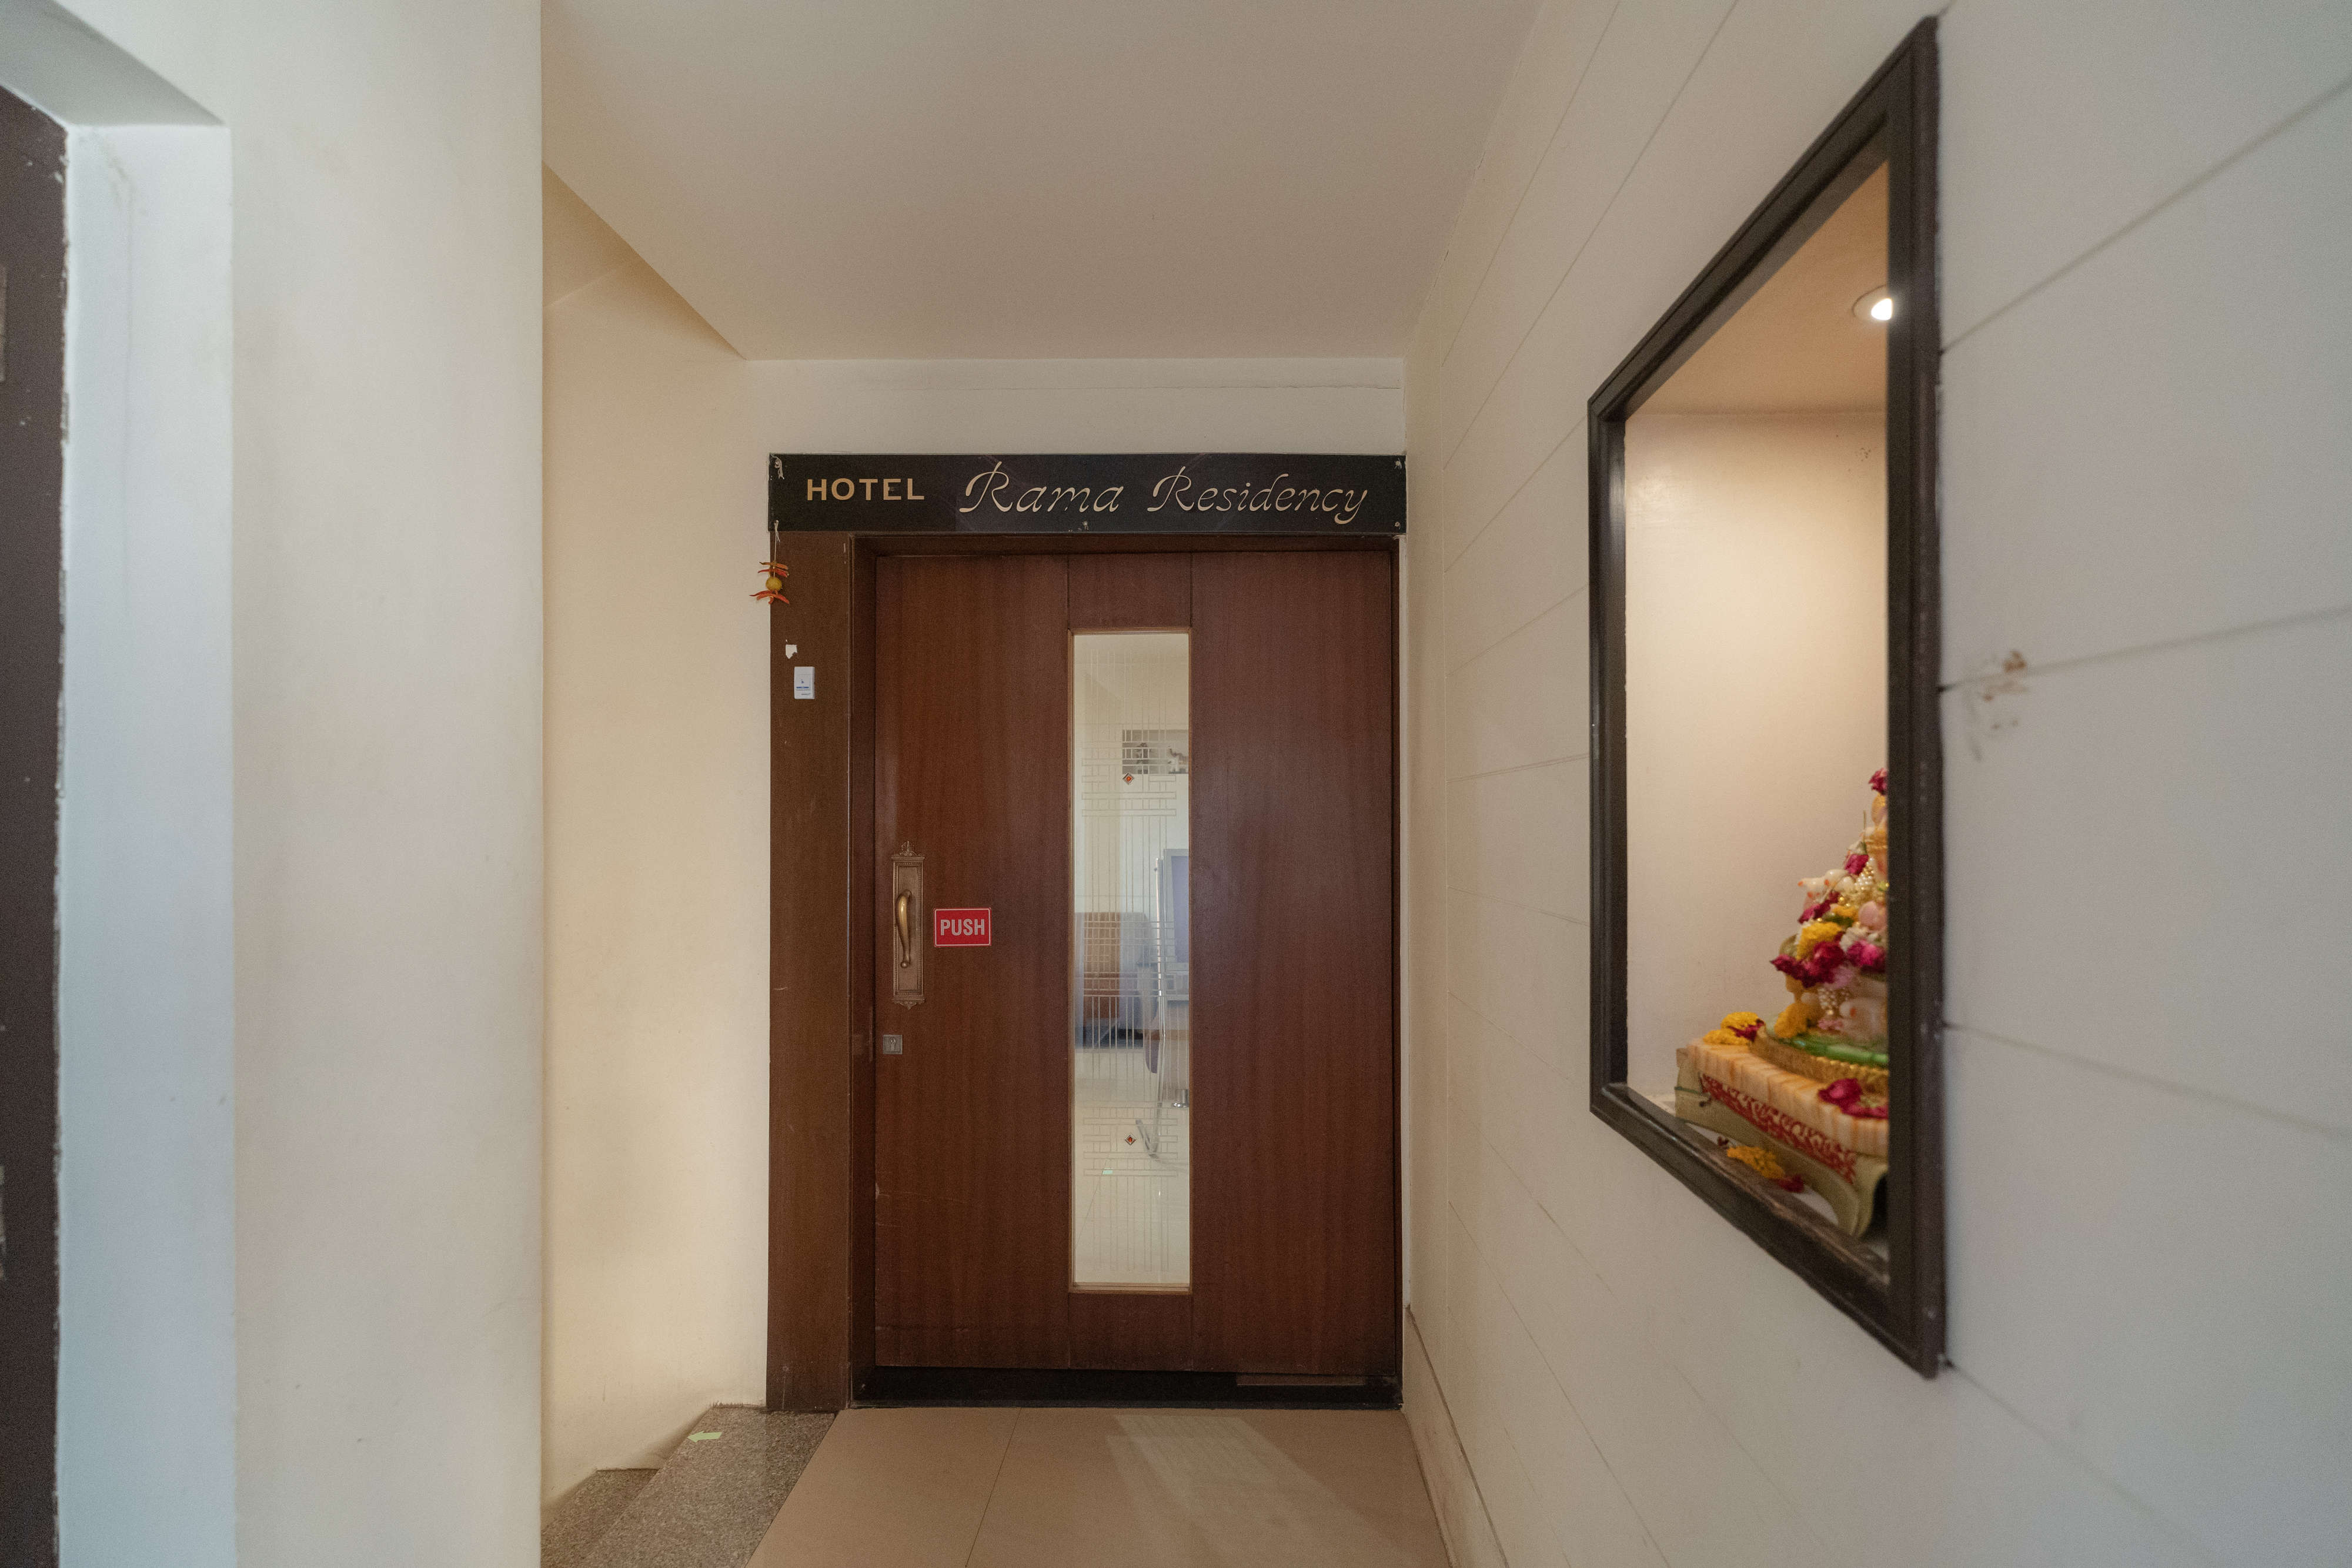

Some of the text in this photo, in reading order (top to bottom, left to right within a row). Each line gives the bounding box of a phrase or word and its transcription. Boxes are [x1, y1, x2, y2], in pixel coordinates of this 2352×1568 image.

[807, 460, 1368, 525] HOTEL Rama Residency
[940, 918, 985, 936] PUSH
